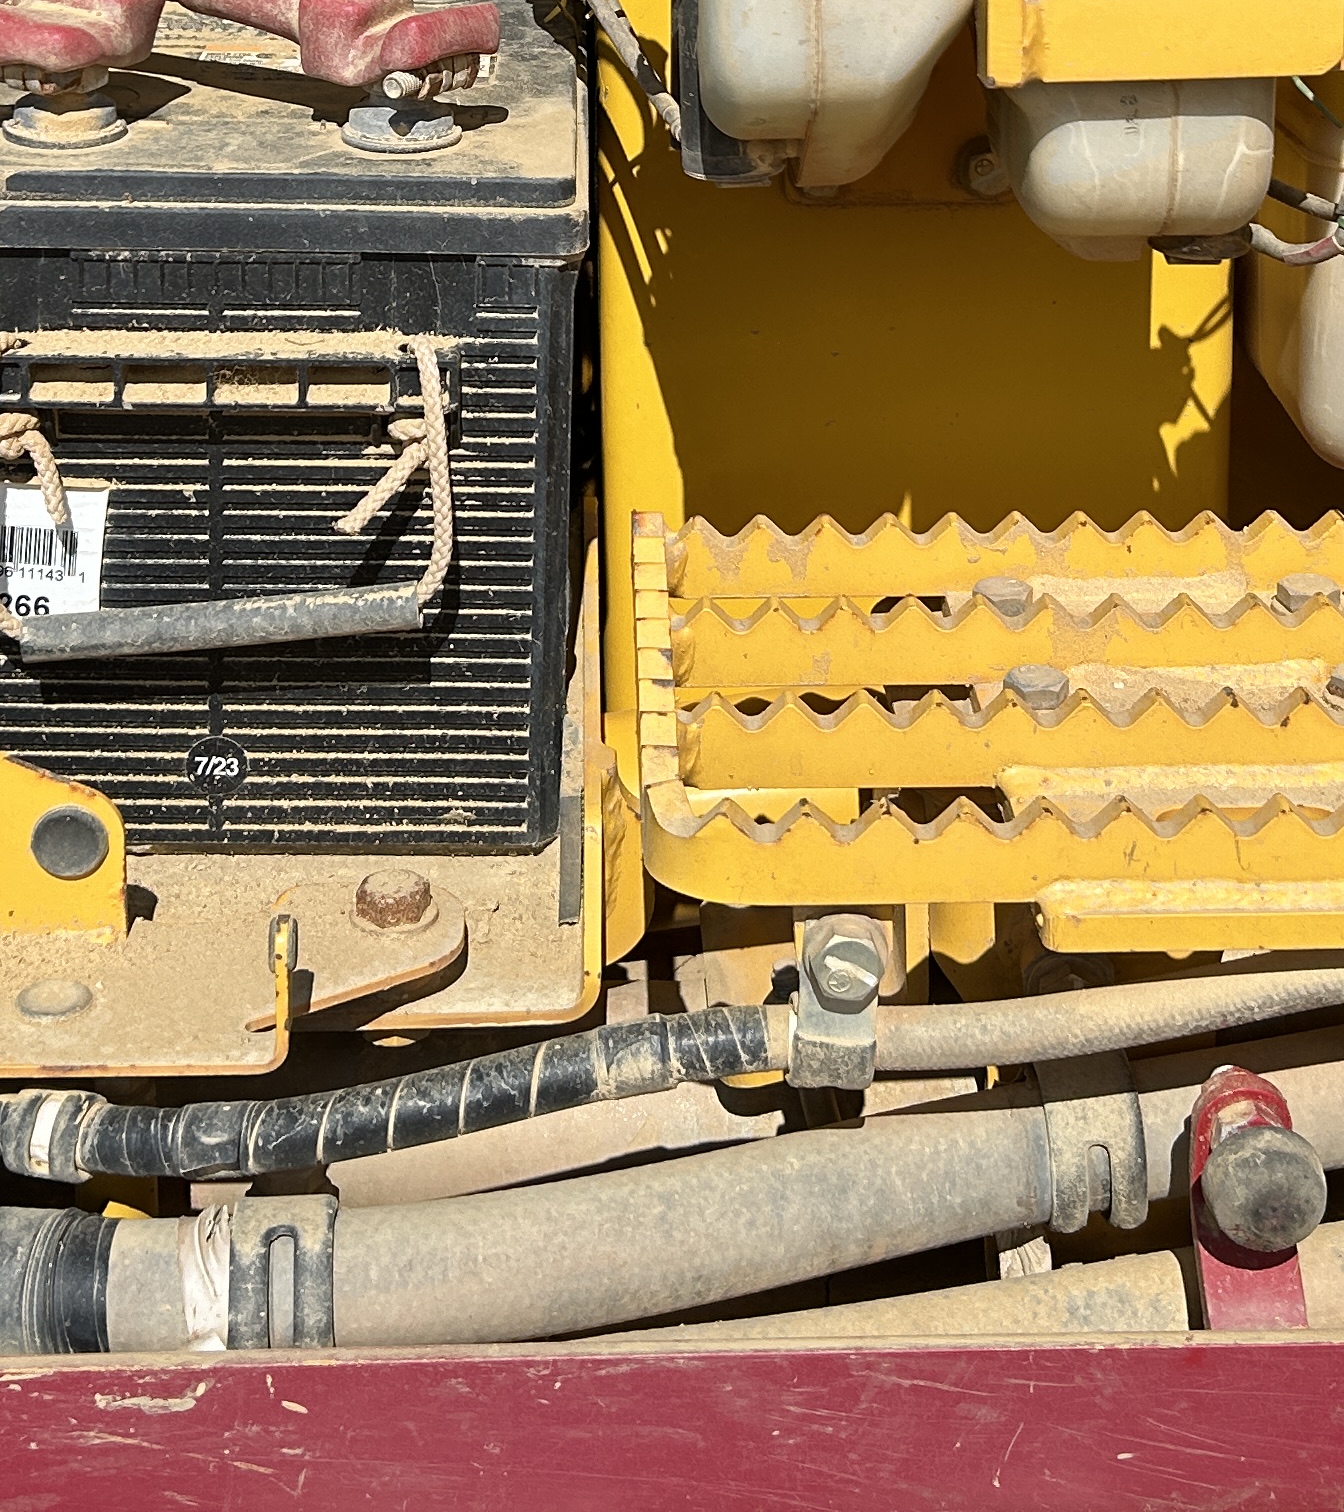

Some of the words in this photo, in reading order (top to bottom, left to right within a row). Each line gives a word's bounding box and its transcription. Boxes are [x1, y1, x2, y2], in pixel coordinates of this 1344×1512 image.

[19, 567, 64, 582] 11143
[79, 571, 85, 584] 1
[194, 756, 239, 777] 7/23
